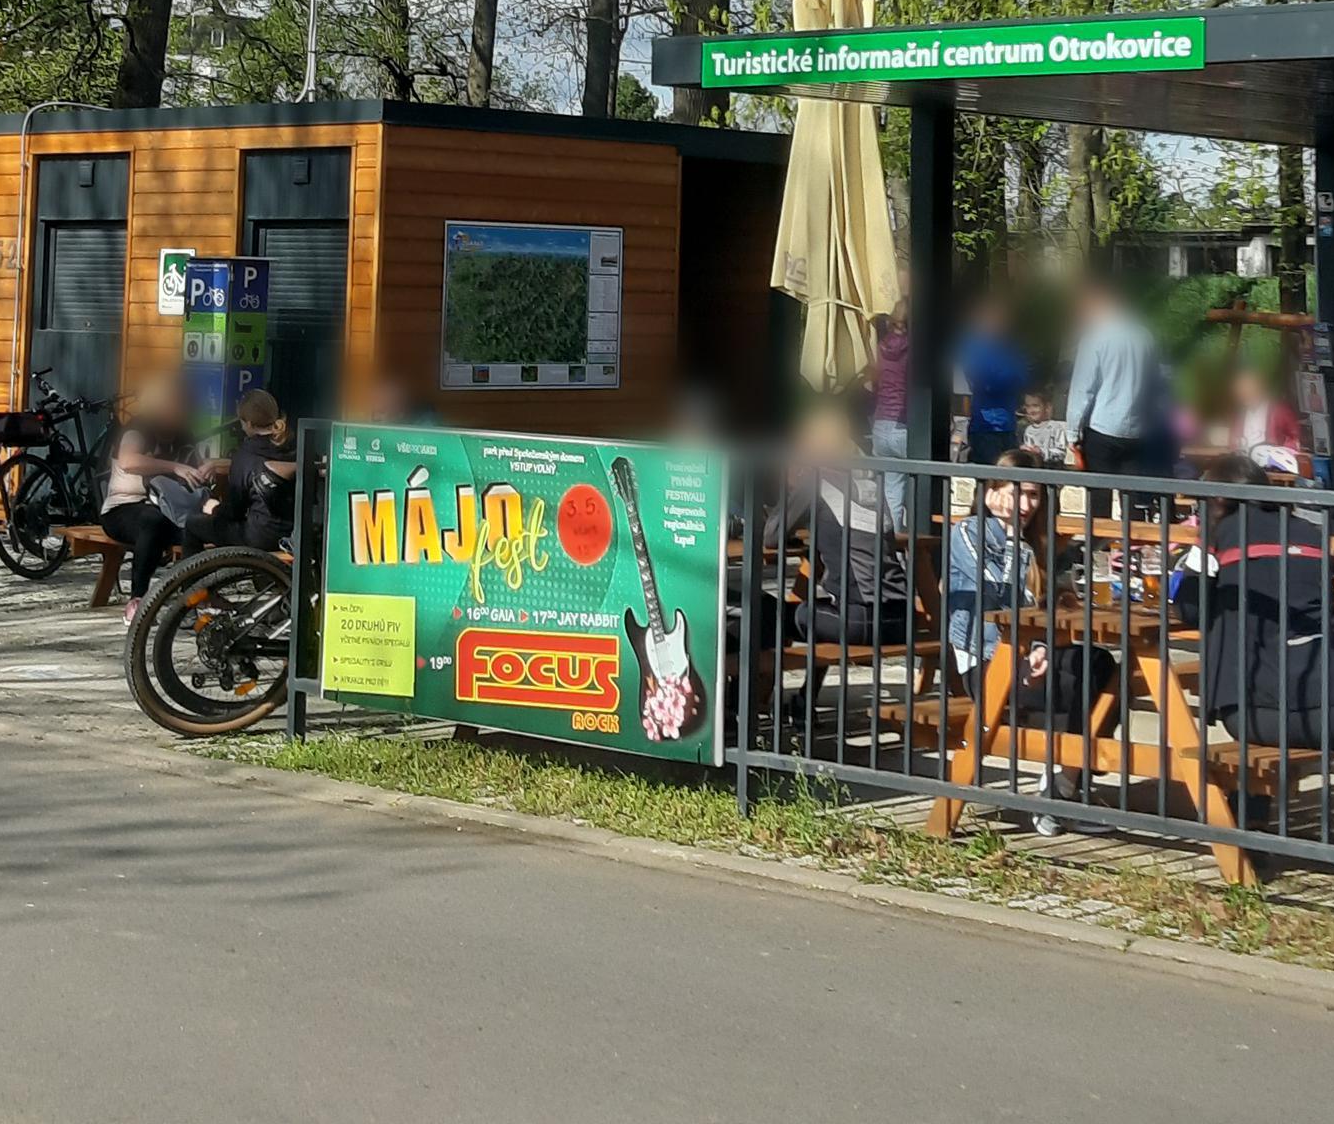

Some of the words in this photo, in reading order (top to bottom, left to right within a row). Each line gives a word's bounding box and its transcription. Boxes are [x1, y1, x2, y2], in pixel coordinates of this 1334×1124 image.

[712, 46, 815, 77] Turistické
[816, 40, 942, 72] informační
[944, 36, 1044, 67] centrum
[1047, 29, 1193, 62] Otrokovice
[510, 461, 533, 472] VSTUP
[665, 489, 707, 503] FESTIVALU
[348, 464, 524, 566] MÁJO
[471, 497, 550, 604] fest
[490, 608, 516, 623] GAIA
[558, 612, 579, 626] JAY
[579, 612, 619, 628] RABBIT
[341, 619, 354, 630] 20
[355, 618, 386, 632] DRUHŮ
[387, 621, 401, 633] PIV
[455, 626, 621, 713] FOCUS
[571, 712, 620, 733] ROCK
